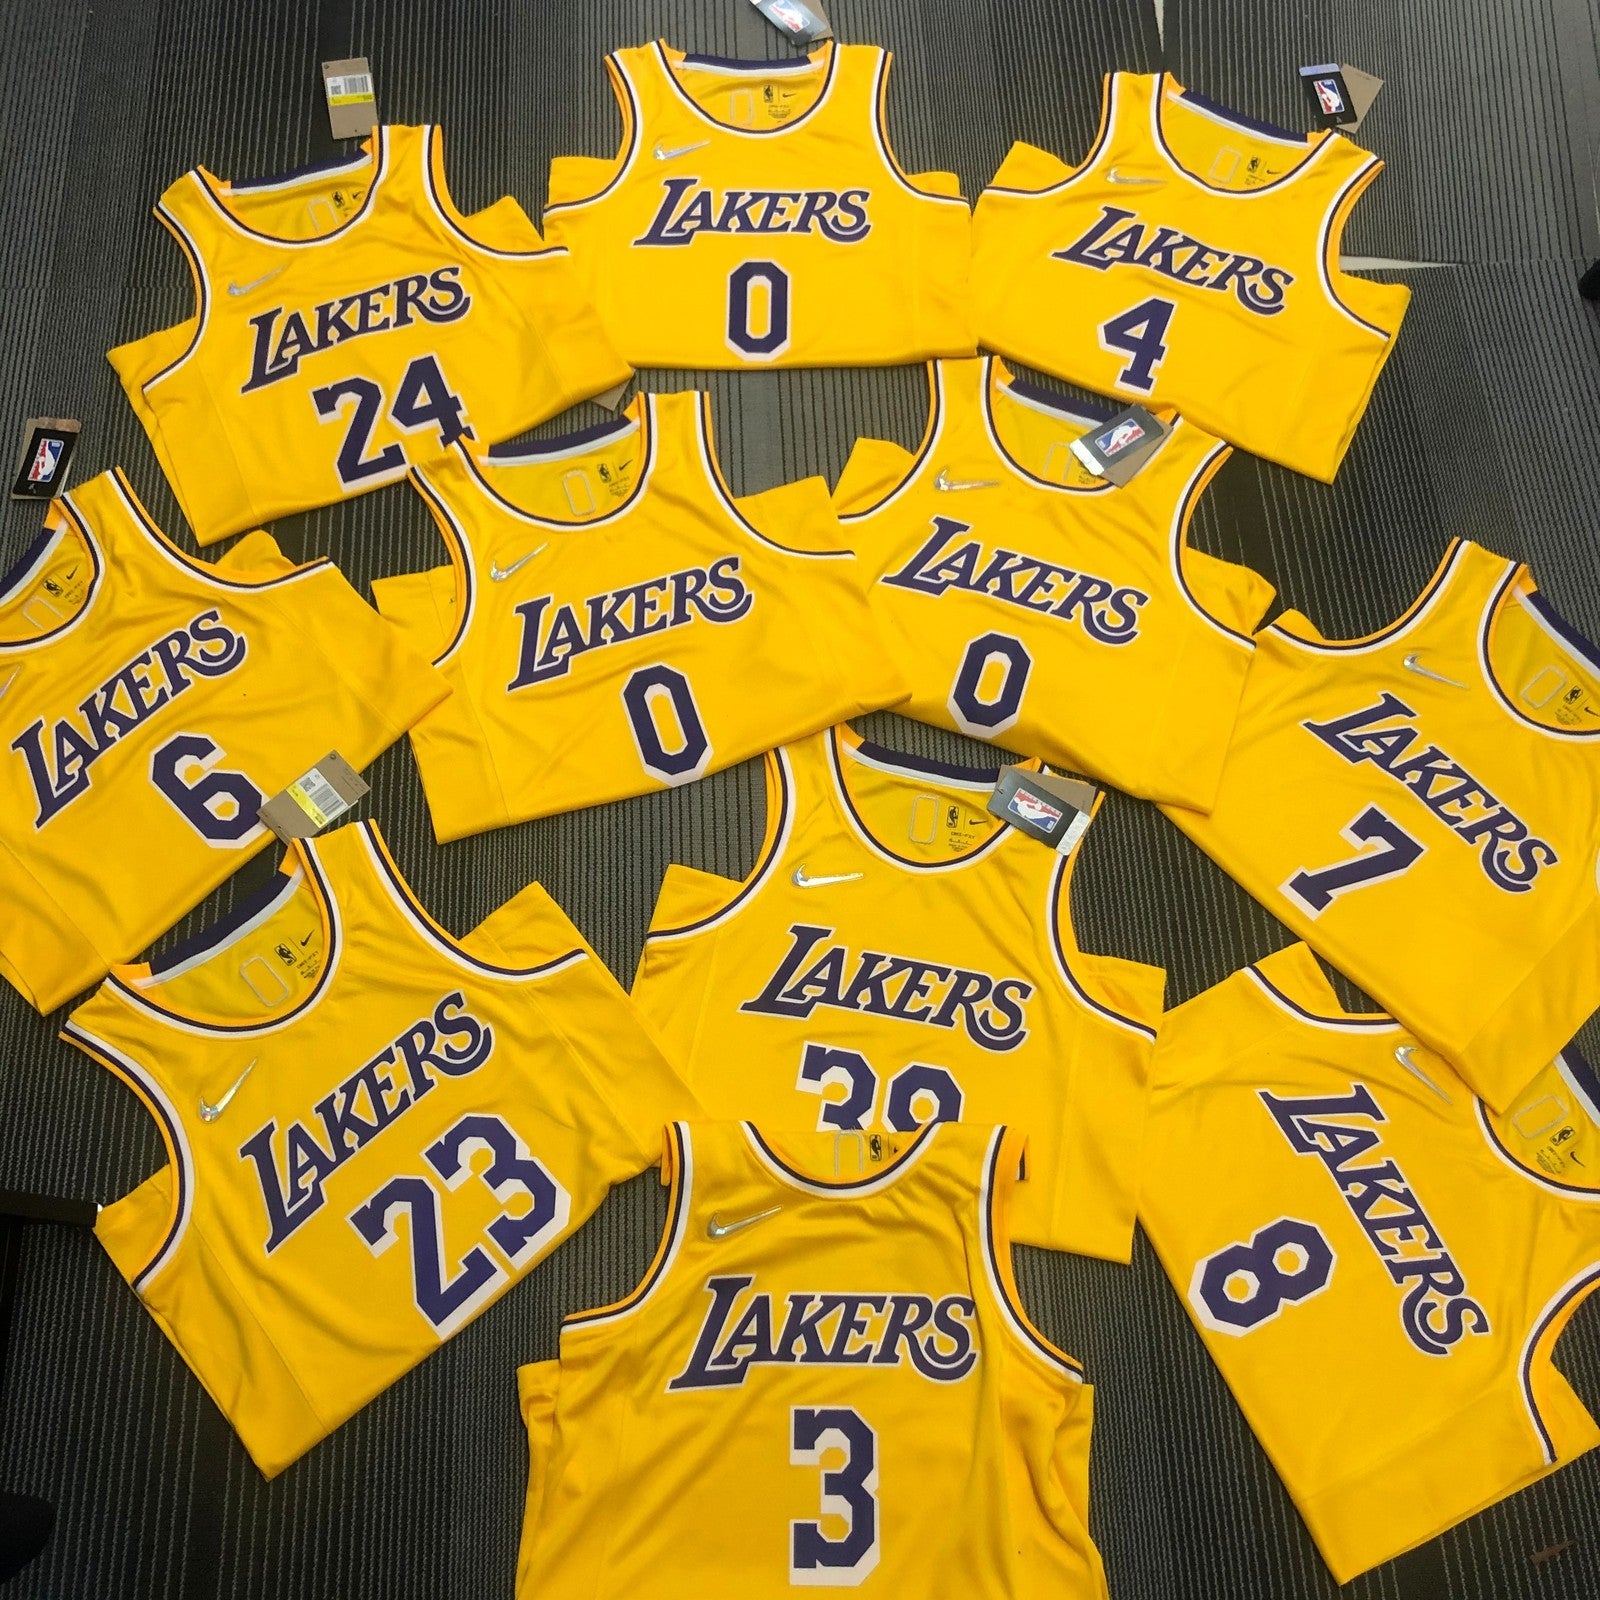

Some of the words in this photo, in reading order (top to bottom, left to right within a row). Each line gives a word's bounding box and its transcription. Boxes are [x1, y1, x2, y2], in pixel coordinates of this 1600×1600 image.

[631, 176, 873, 248] LAKERS
[1050, 204, 1296, 317] LAKERS
[240, 265, 472, 395] LAKERS
[725, 259, 792, 362] 0
[1097, 295, 1178, 397] 4
[310, 353, 476, 493] 24
[506, 555, 755, 693] LAKERS
[879, 515, 1151, 647] LAKERS
[10, 607, 249, 831] LAKERS
[621, 663, 713, 789] 0
[947, 630, 1034, 740] 0
[149, 731, 270, 848] 6
[1300, 690, 1558, 893] LAKERS
[1280, 802, 1428, 921] 7
[738, 923, 1037, 1054] LAKERS
[239, 990, 495, 1257] LAKERS
[345, 1113, 571, 1342] 23
[1188, 1216, 1337, 1337] 8
[1256, 1082, 1492, 1358] LAKERS
[666, 1274, 980, 1393] LAKERS
[789, 1405, 880, 1586] 3
